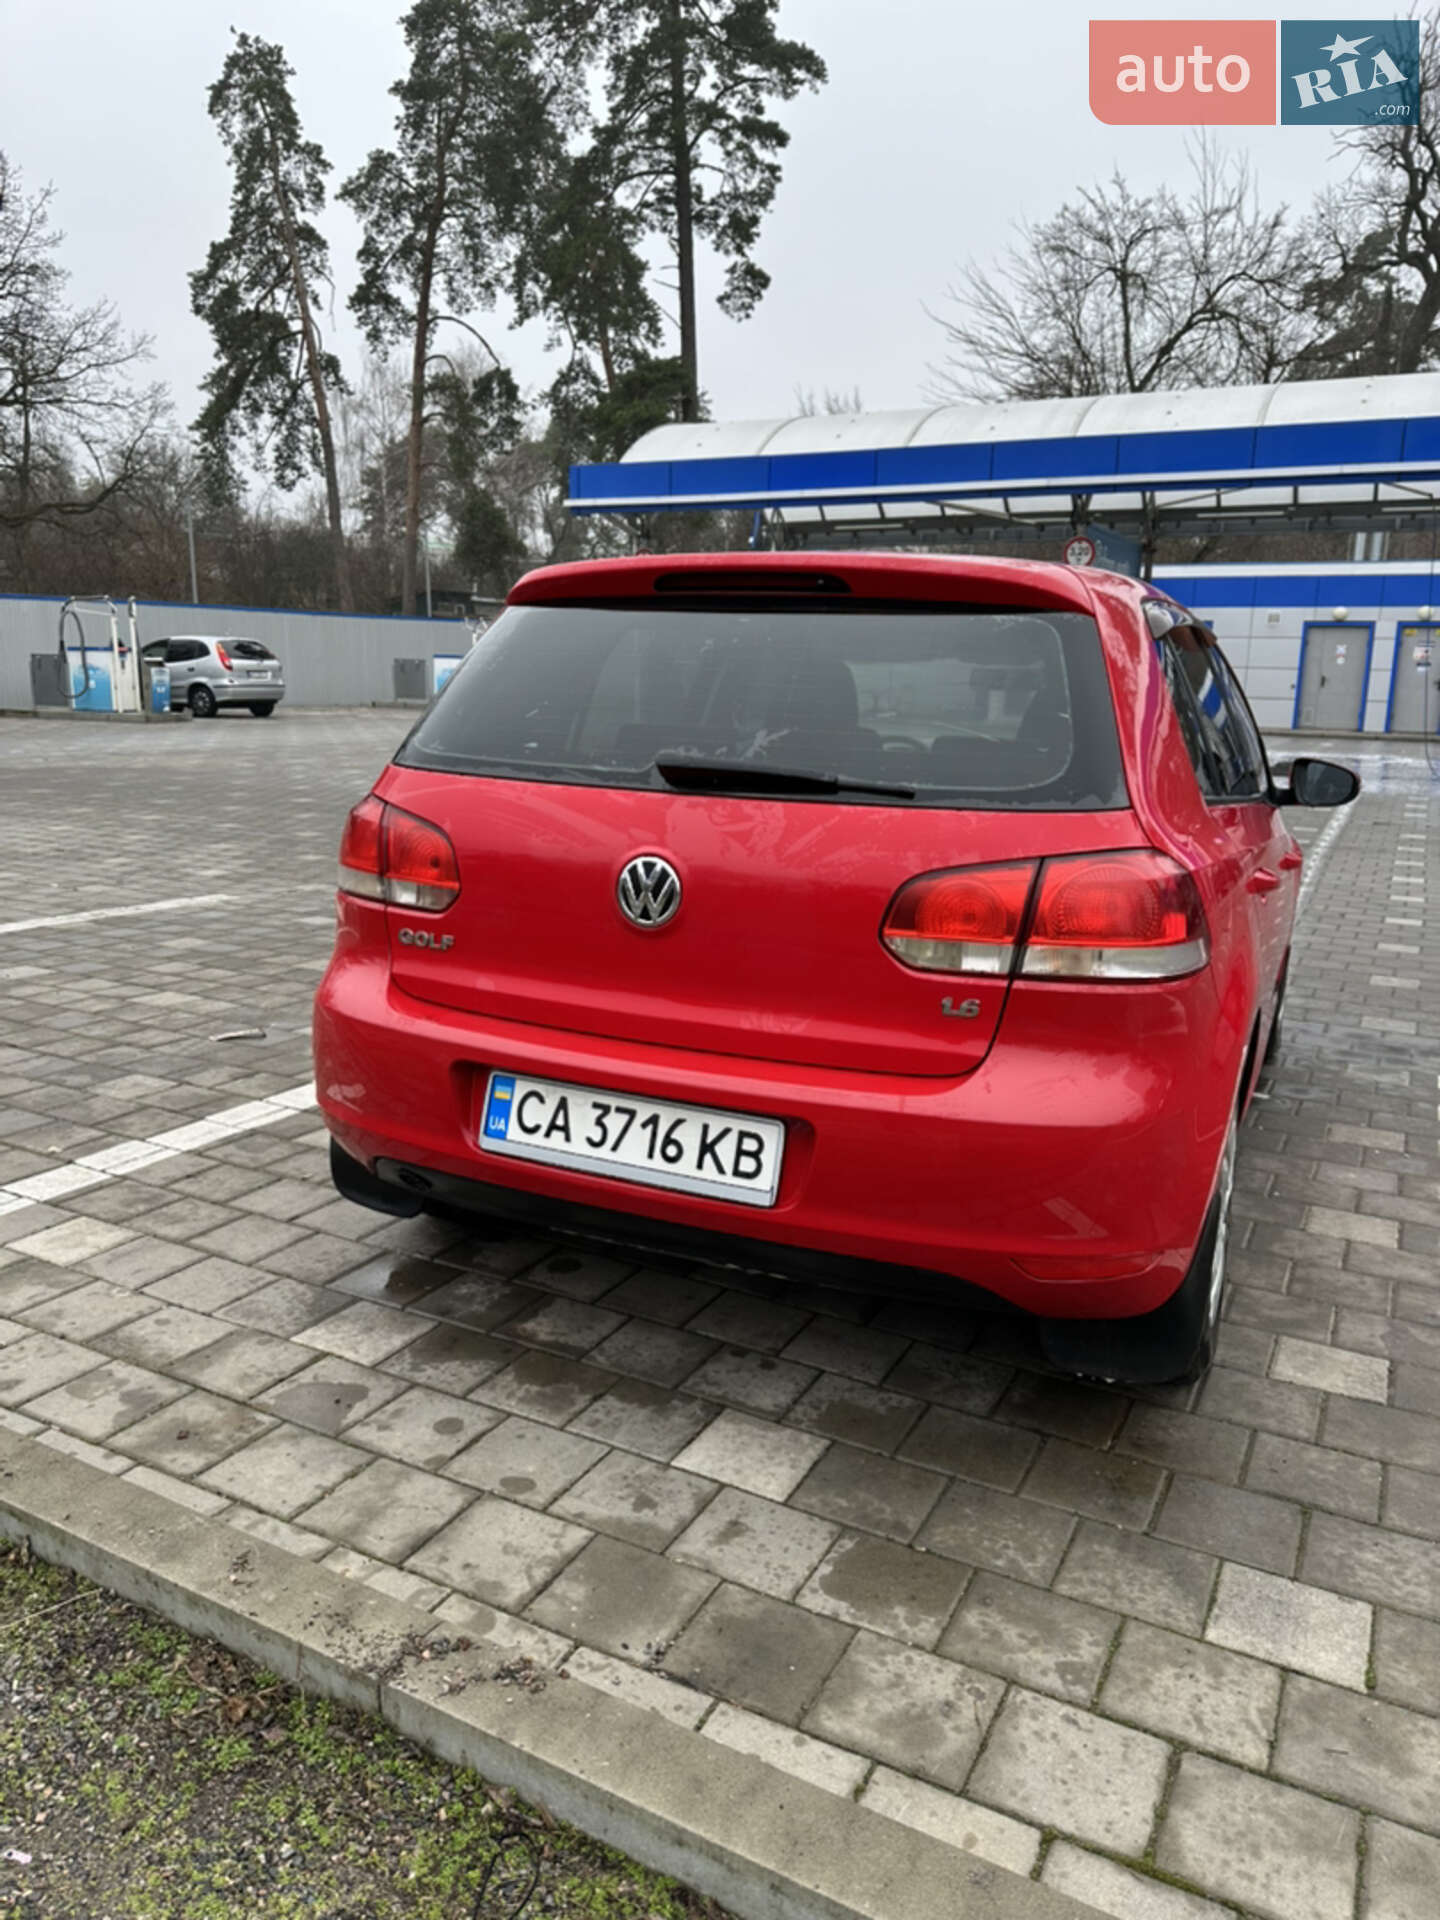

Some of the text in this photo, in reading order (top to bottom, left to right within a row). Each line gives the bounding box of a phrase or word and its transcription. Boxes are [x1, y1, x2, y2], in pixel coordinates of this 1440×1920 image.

[618, 856, 681, 927] VW
[398, 928, 455, 951] GOLF
[488, 1116, 506, 1132] UA
[517, 1090, 765, 1180] CA 3716 KB
